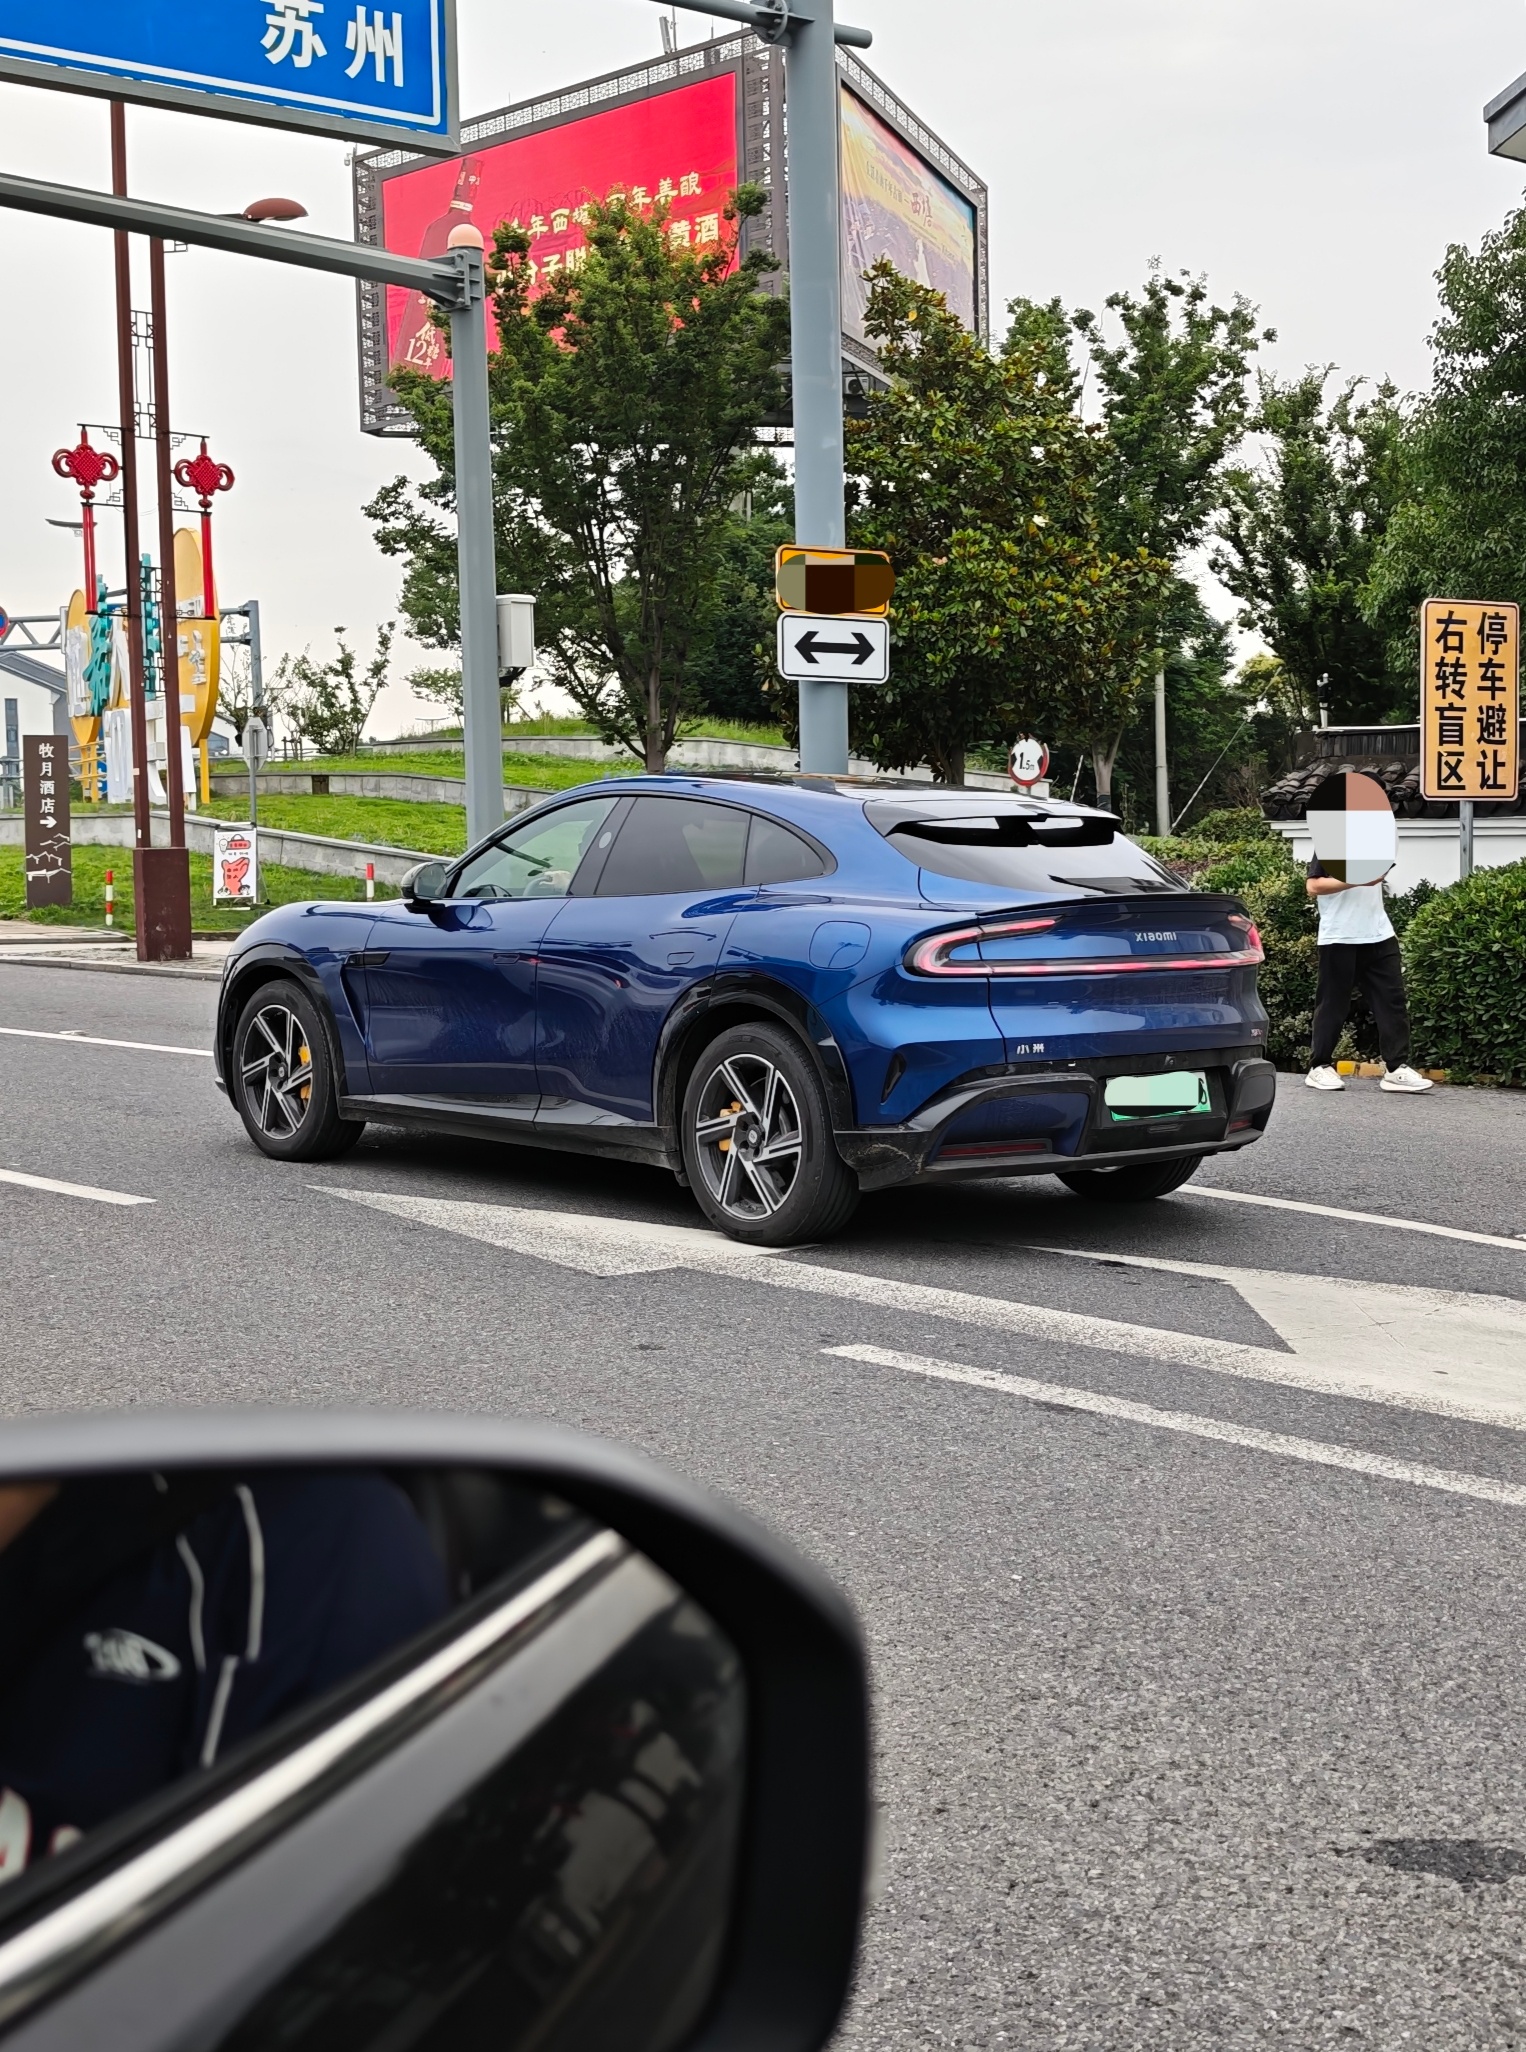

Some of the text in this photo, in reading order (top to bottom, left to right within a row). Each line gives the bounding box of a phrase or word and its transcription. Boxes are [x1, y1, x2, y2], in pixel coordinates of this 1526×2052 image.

[260, 0, 404, 87] 苏州
[1435, 610, 1467, 790] 右转盲区
[1476, 611, 1508, 790] 停车避让
[39, 743, 55, 814] 牧月酒店
[1016, 1043, 1045, 1055] 小米
